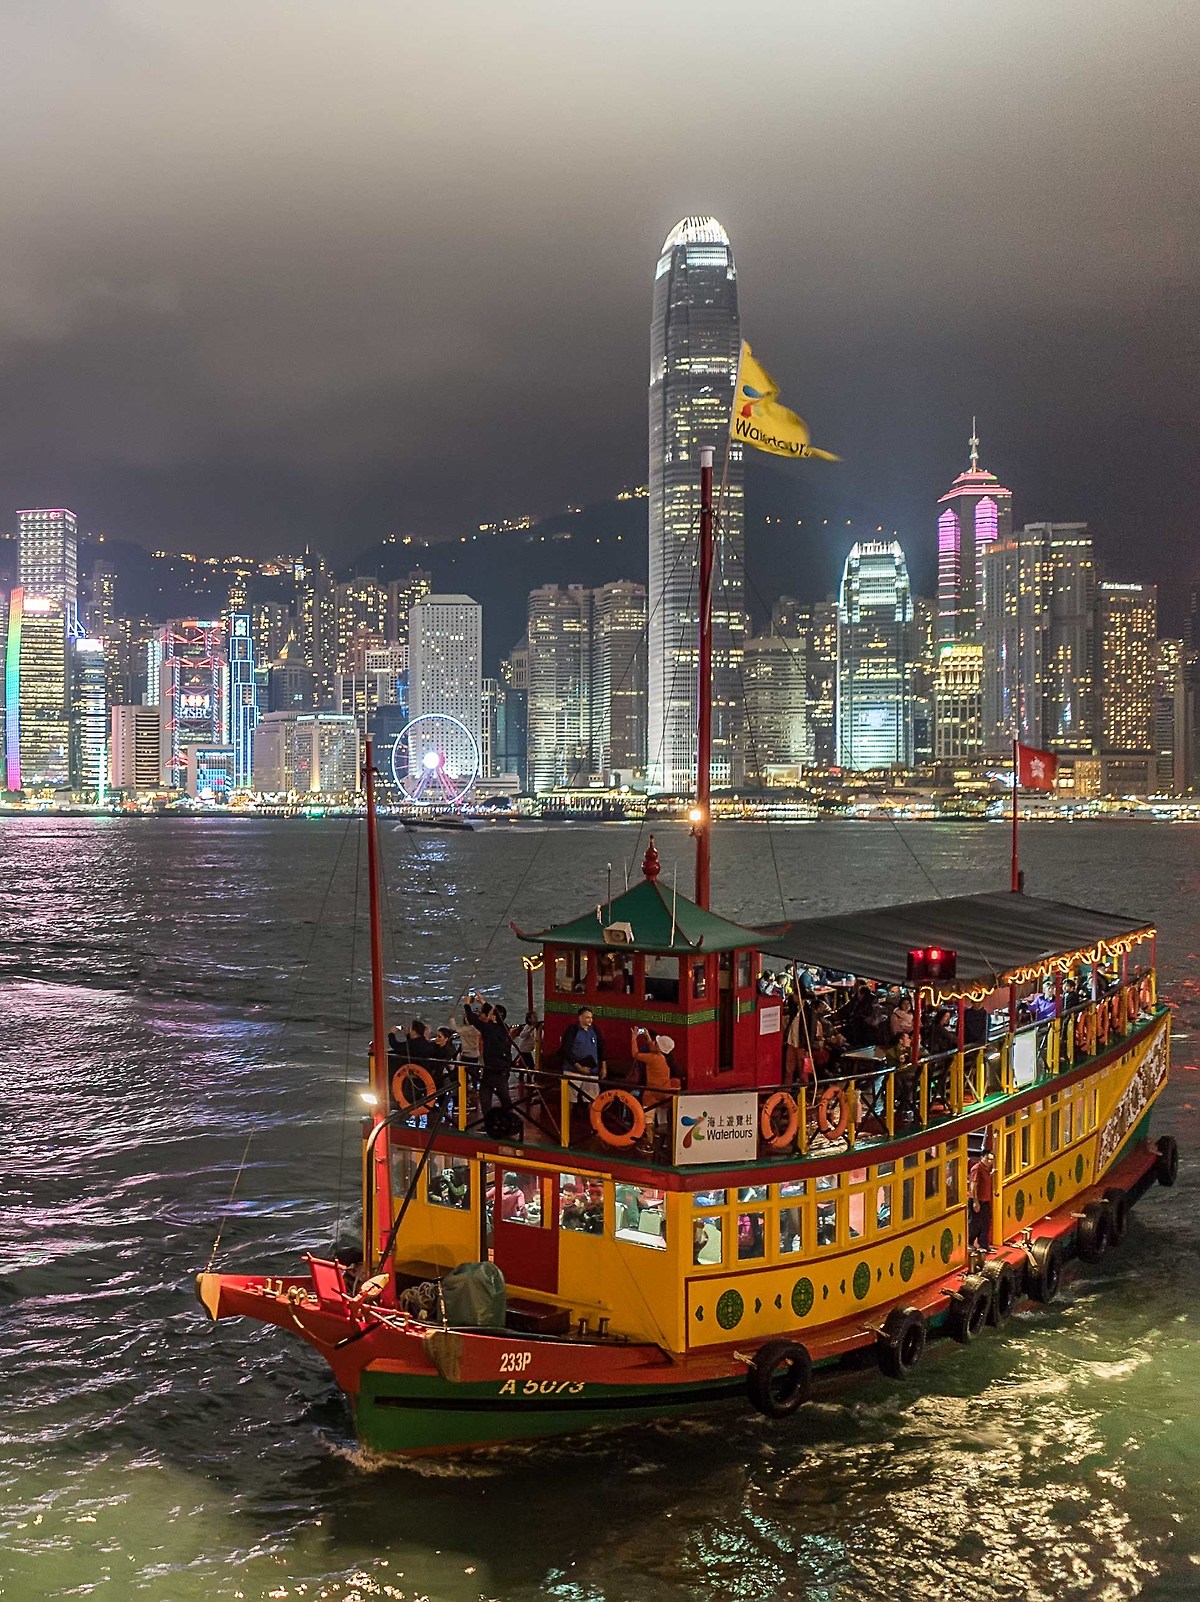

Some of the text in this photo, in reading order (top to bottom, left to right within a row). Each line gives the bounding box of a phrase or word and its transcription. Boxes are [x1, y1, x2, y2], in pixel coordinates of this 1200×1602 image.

[180, 707, 213, 719] HSBC
[707, 1129, 753, 1140] Watertours
[499, 1352, 532, 1372] 233P
[498, 1379, 516, 1395] A
